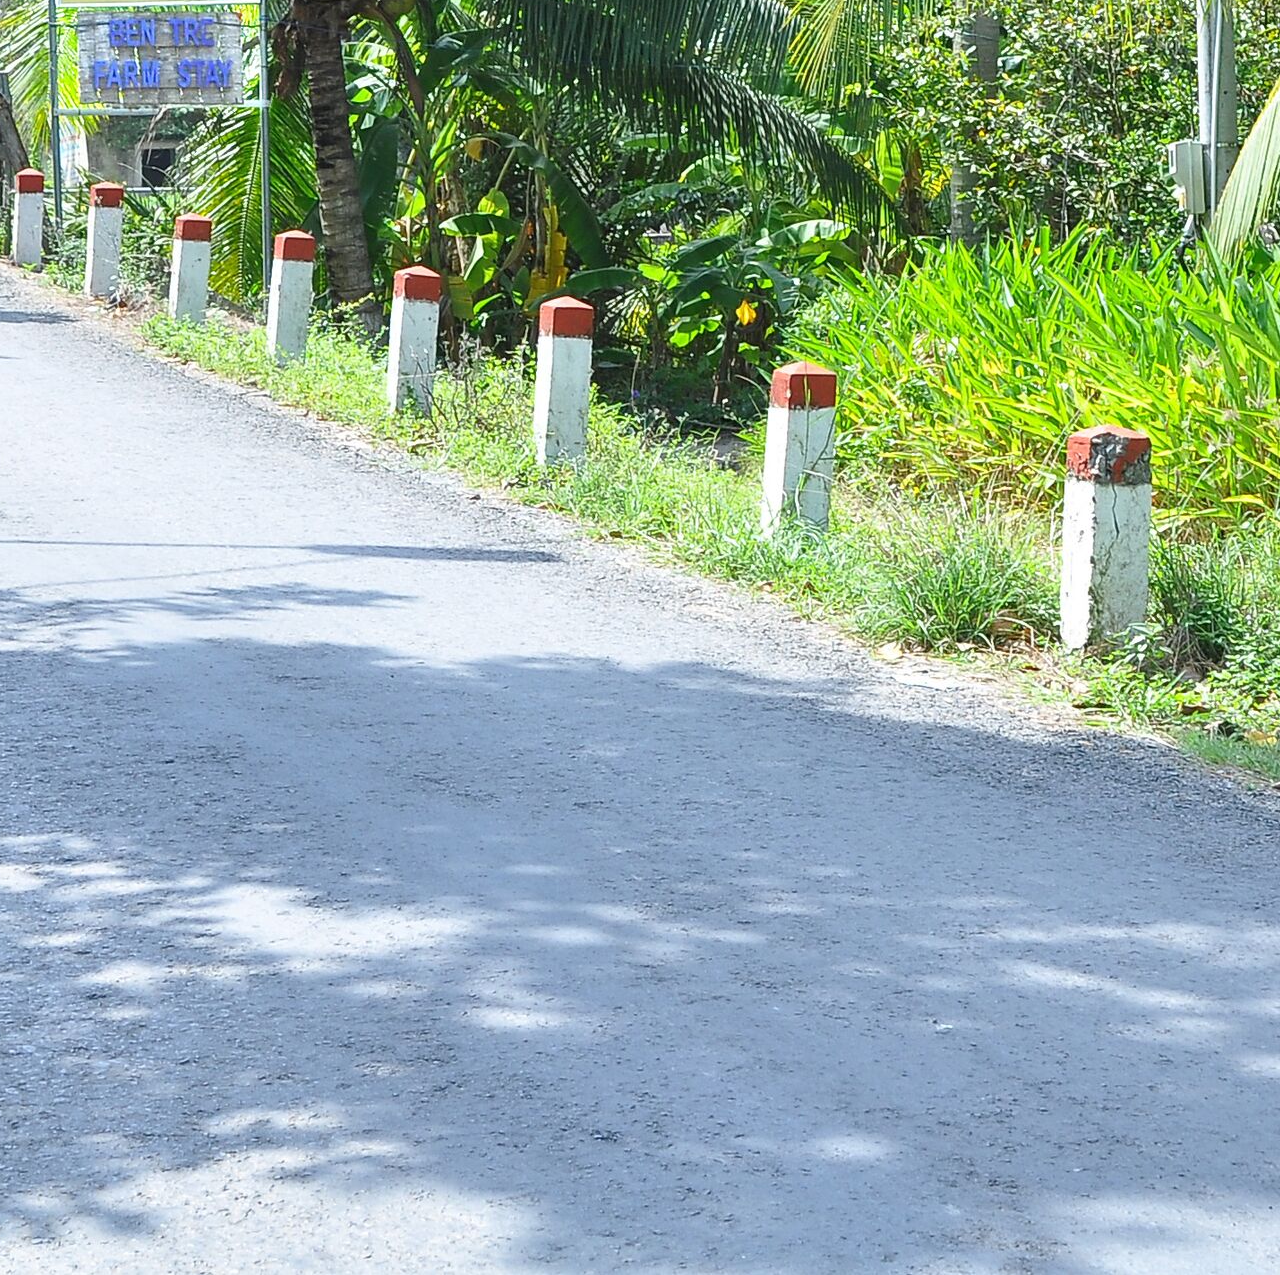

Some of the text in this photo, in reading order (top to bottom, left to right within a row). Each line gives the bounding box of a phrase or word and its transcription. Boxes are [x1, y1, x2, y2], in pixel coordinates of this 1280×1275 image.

[109, 17, 215, 47] BEN TRE
[93, 58, 233, 90] FARM STAY
